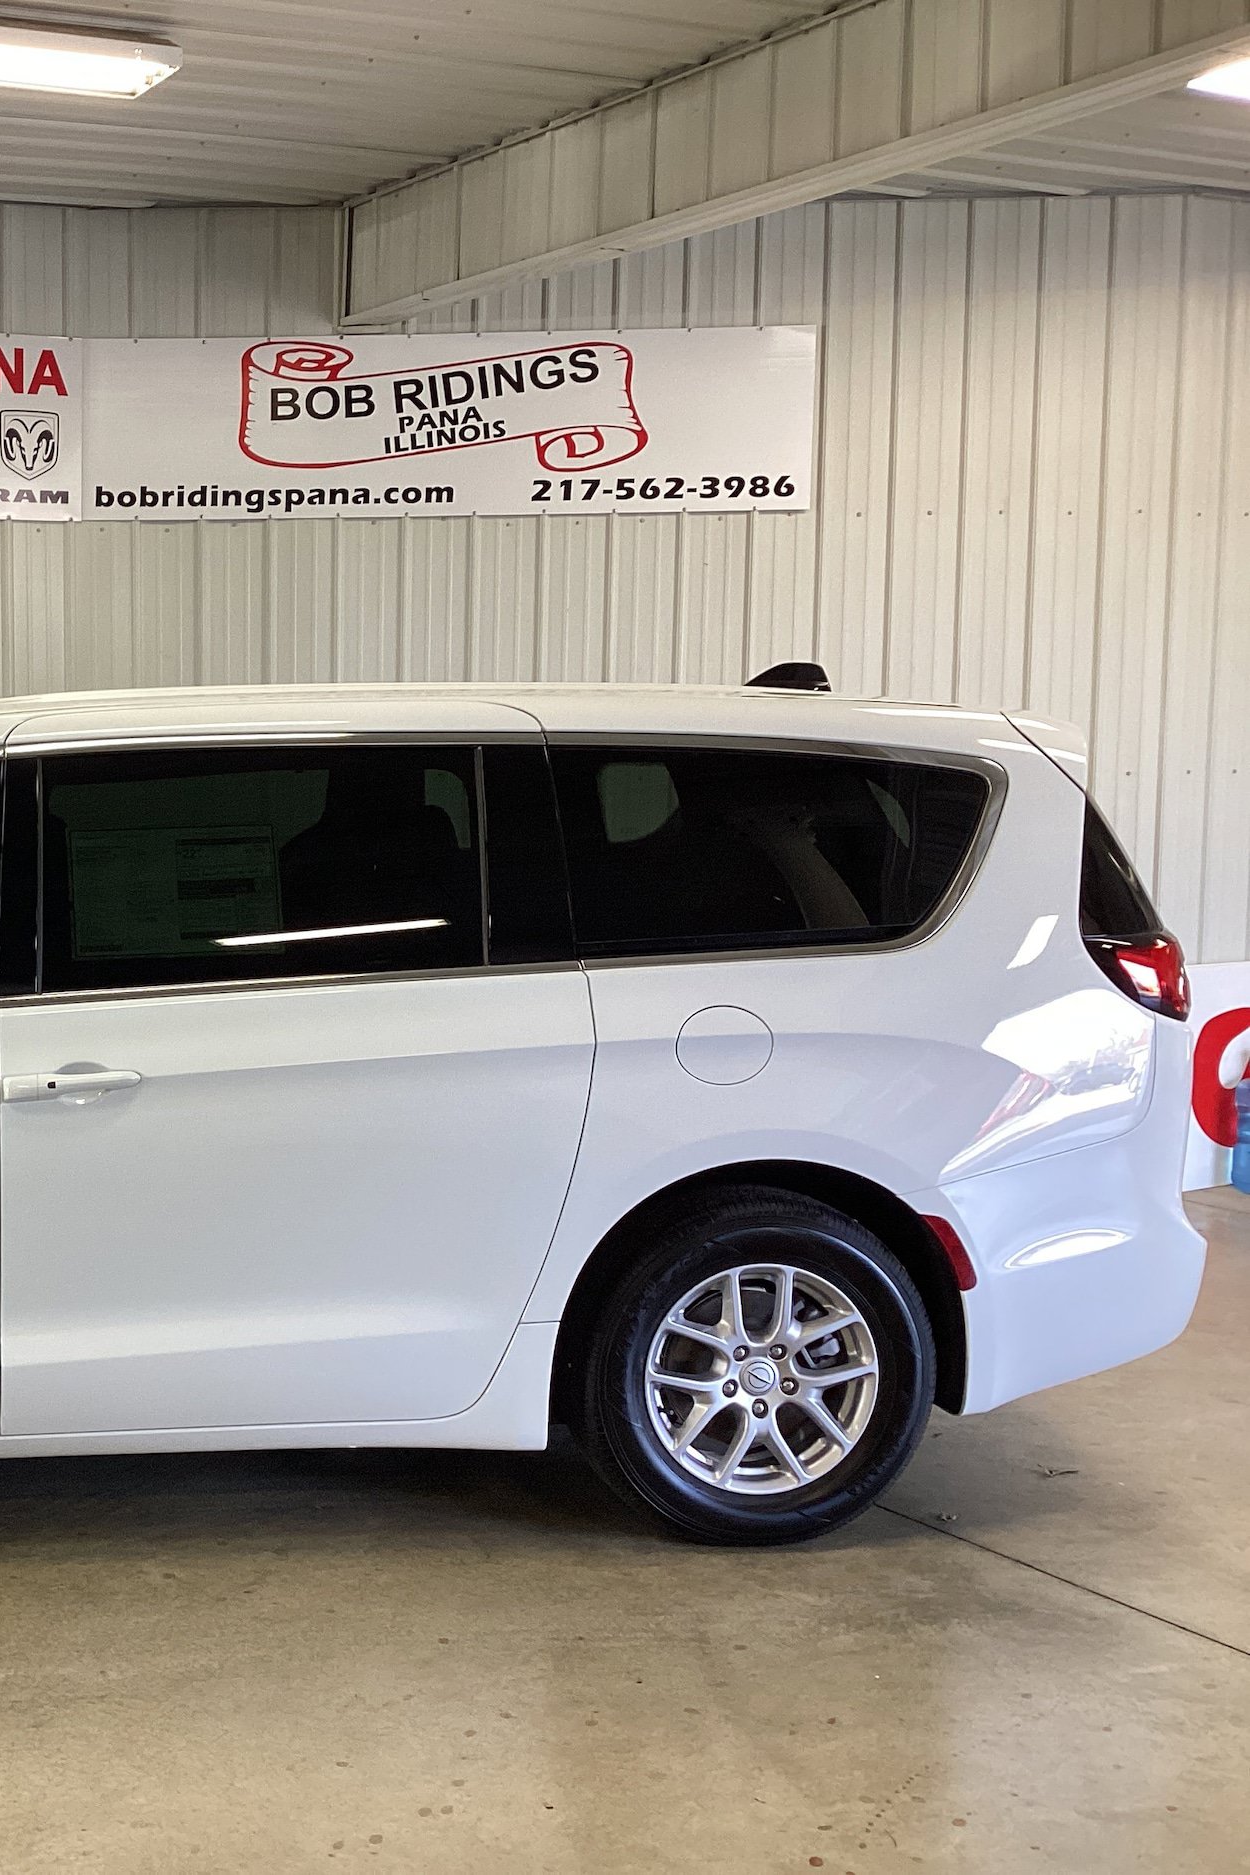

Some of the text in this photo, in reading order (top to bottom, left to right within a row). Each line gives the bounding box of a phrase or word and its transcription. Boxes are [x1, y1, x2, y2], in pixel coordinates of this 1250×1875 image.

[270, 348, 600, 421] BOB RIDINGS
[398, 406, 484, 434] PANA
[384, 420, 507, 454] ILLINOIS
[95, 485, 454, 514] bobridingspana.com
[531, 475, 795, 502] 217-562-3986
